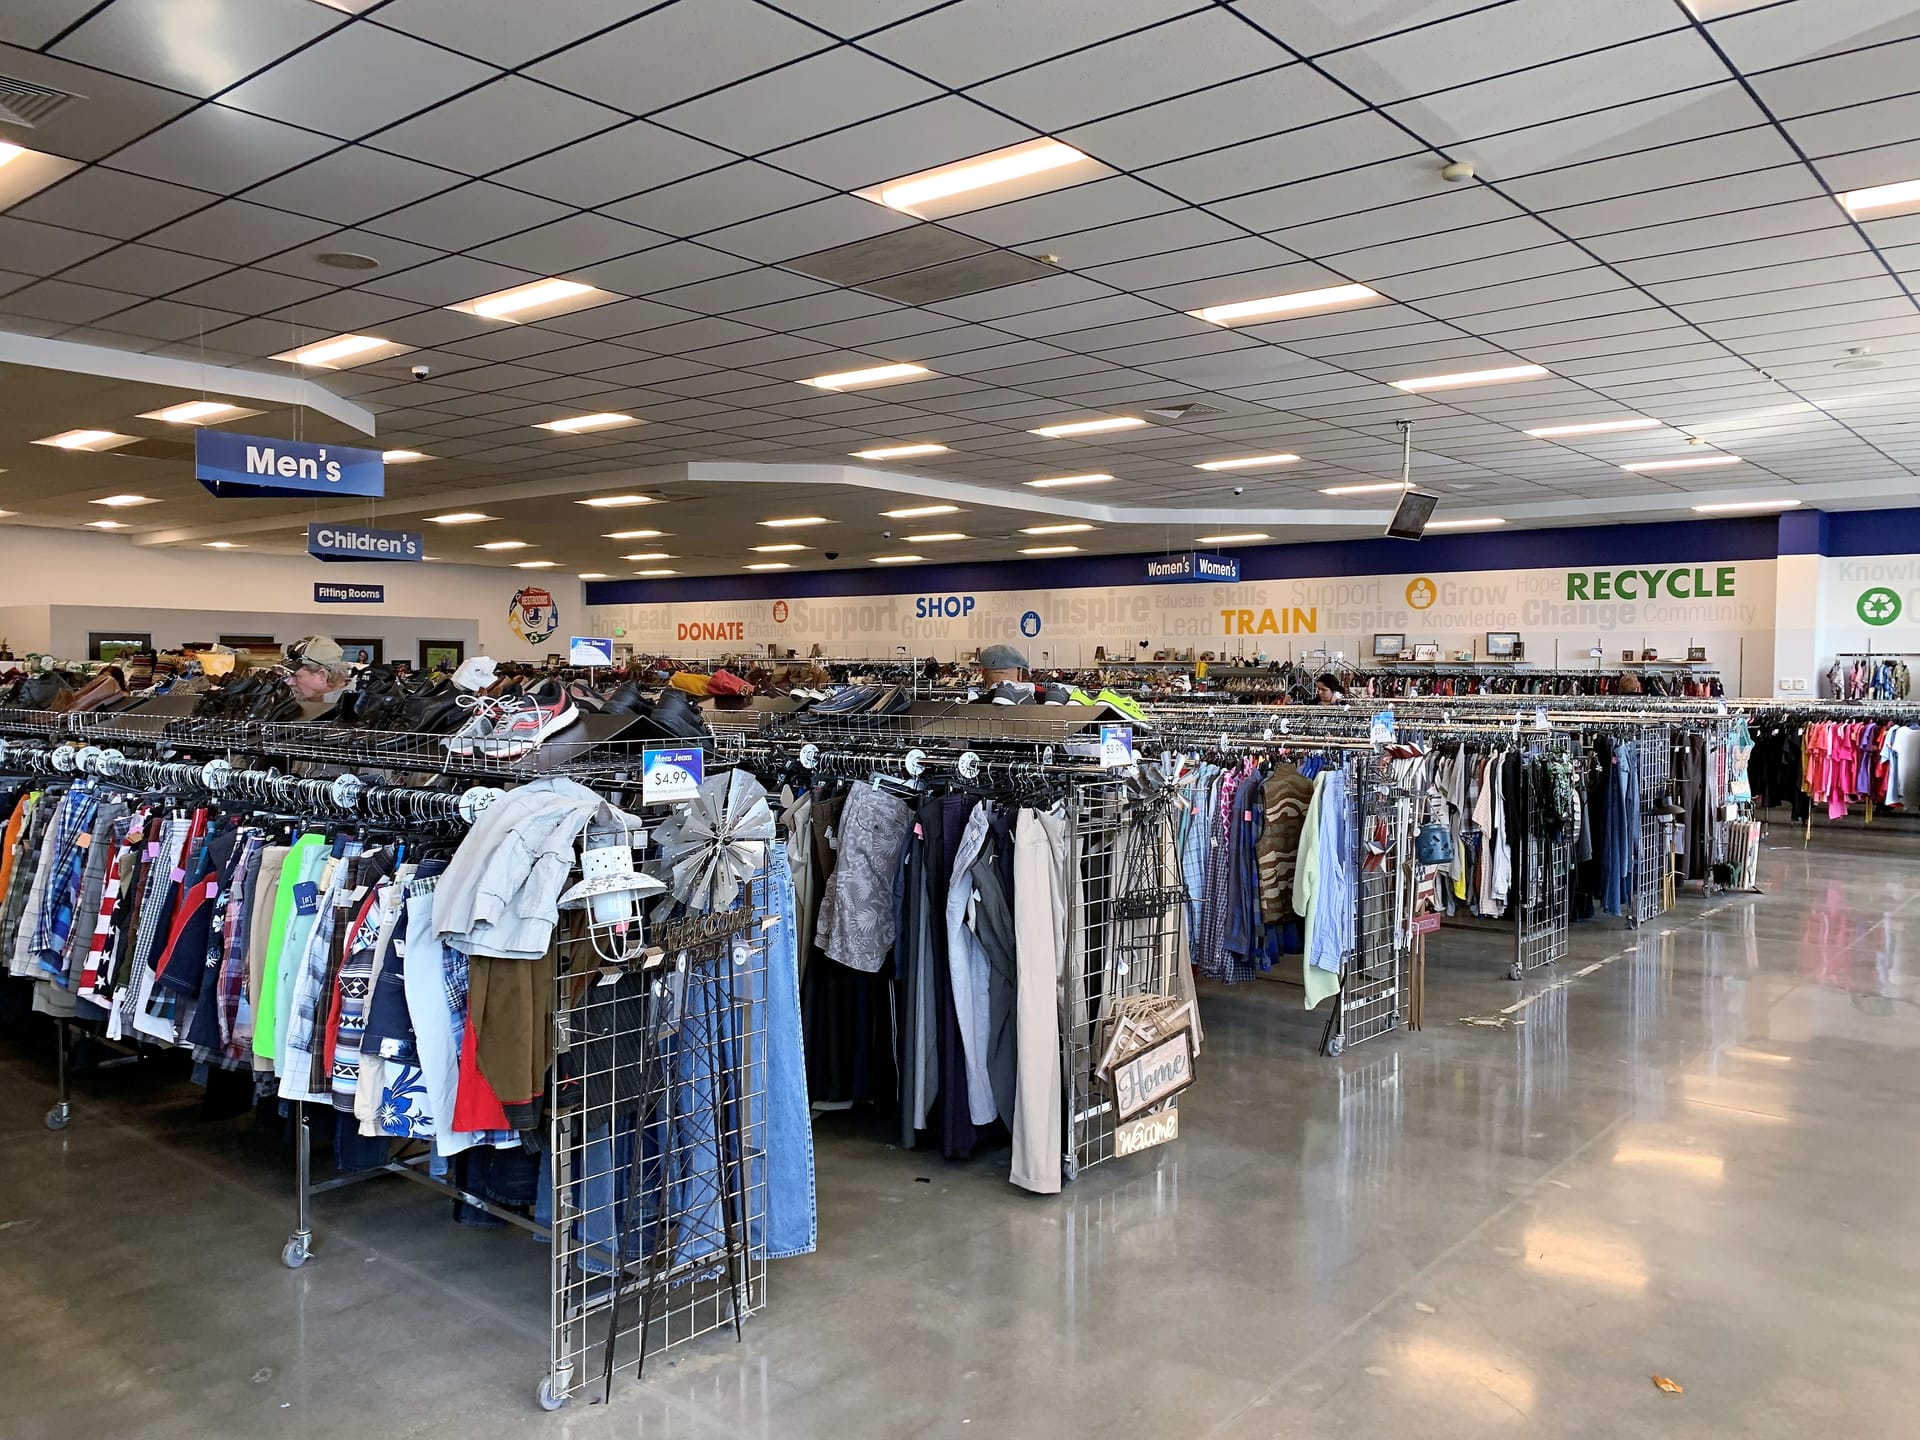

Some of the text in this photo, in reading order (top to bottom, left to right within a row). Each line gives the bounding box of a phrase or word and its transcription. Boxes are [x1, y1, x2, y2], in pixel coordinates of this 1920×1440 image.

[247, 446, 342, 482] Men's
[317, 529, 416, 554] Children's
[1148, 556, 1190, 577] Women's
[1199, 558, 1237, 577] Women's
[319, 587, 380, 600] Fitting Rooms
[1291, 578, 1384, 611] Support
[1440, 582, 1509, 606] Grow
[1516, 576, 1561, 596] Hope
[1567, 567, 1736, 600] RECYCLE
[916, 596, 976, 618] SHOP
[992, 594, 1025, 613] Skills
[1156, 594, 1205, 609] Educate
[1213, 585, 1268, 606] Skills
[628, 604, 673, 631] Lead
[703, 602, 767, 622] Community
[793, 599, 898, 640] Support
[1044, 590, 1150, 630] Inspire
[1220, 607, 1318, 635] TRAIN
[1327, 608, 1409, 633] Inspire
[1422, 610, 1518, 630] Knowledge
[1522, 600, 1637, 631] Change
[1644, 602, 1757, 625] Community
[677, 622, 744, 640] DONATE
[747, 621, 792, 640] Change
[901, 618, 950, 639] Grow
[968, 611, 1018, 639] Hire
[1162, 611, 1213, 637] Lead
[674, 753, 693, 762] Jeans
[655, 771, 688, 785] $4.99
[1118, 1054, 1186, 1110] Home
[1119, 1115, 1176, 1153] Welcome
